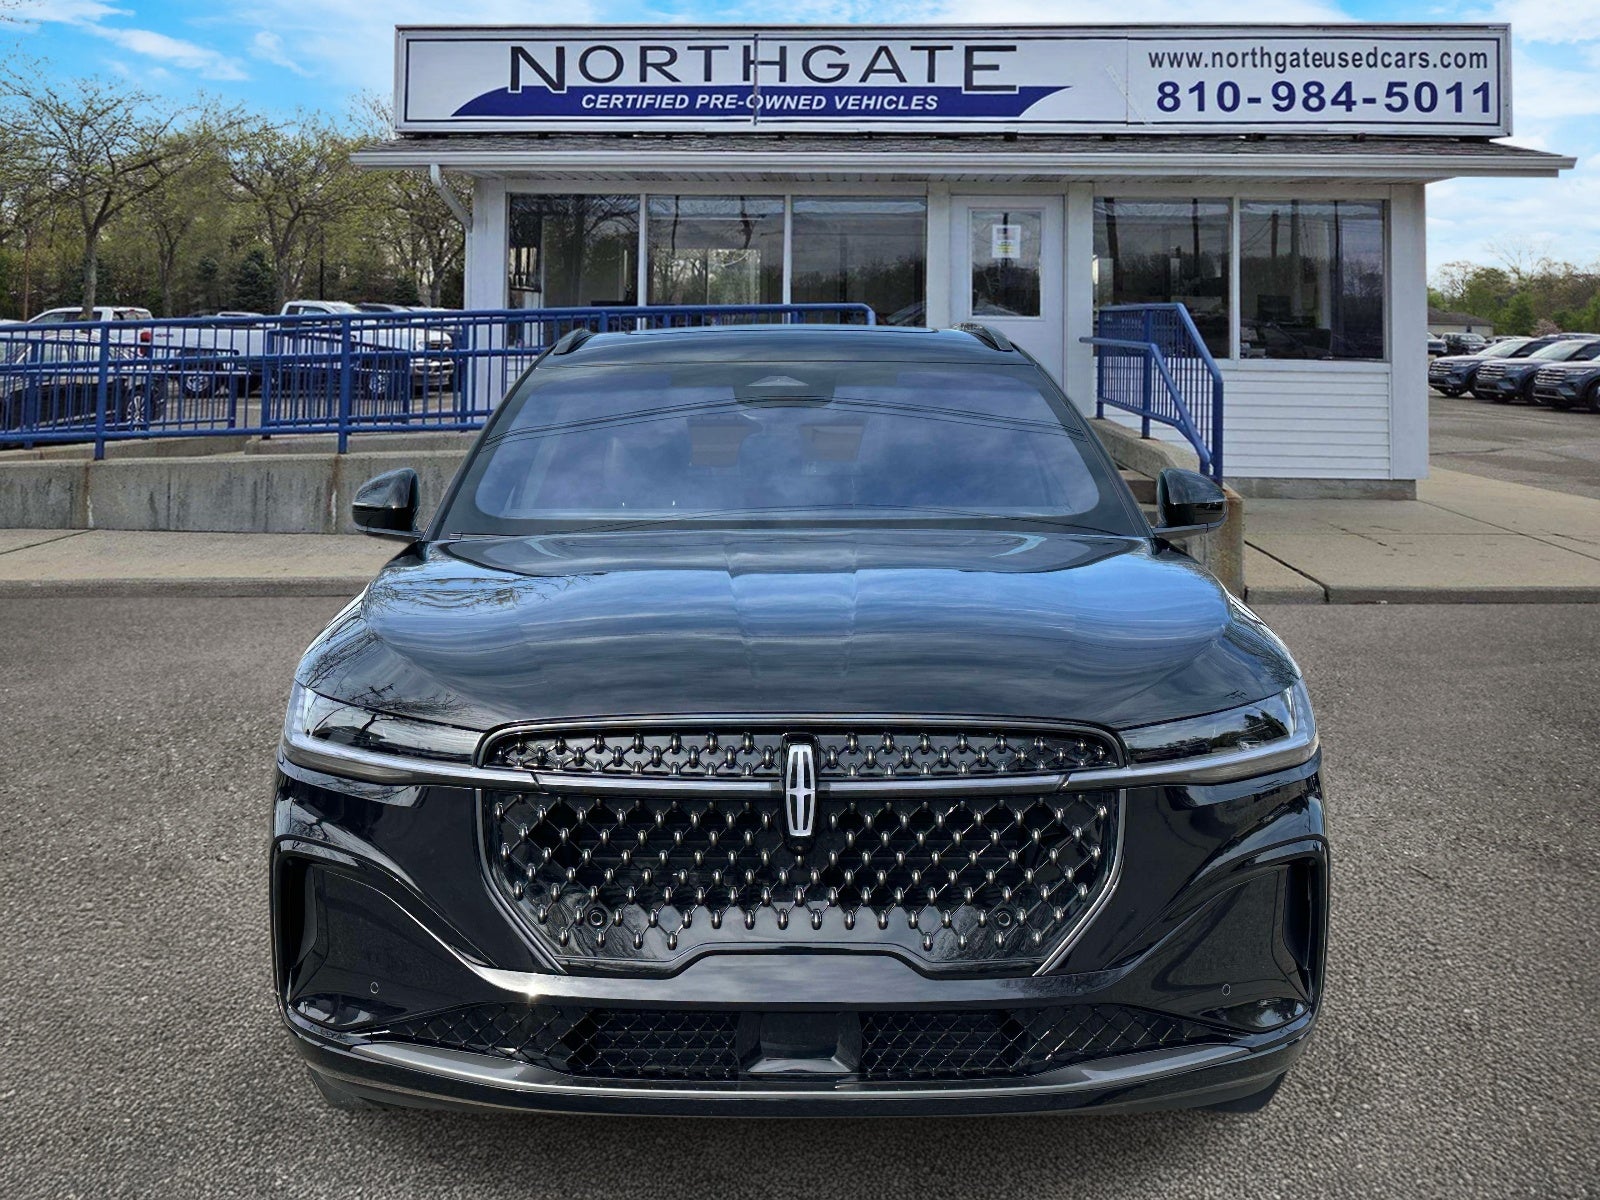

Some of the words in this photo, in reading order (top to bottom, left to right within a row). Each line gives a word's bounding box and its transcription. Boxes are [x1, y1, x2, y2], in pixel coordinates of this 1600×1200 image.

[509, 45, 1017, 92] NORTHGATE
[1148, 47, 1489, 73] www.northgateusedcars.com
[581, 94, 690, 110] CERTIFIED
[695, 93, 827, 111] PRE-OWNED
[834, 96, 938, 111] VEHICLES
[1156, 80, 1491, 114] 810-984-5011
